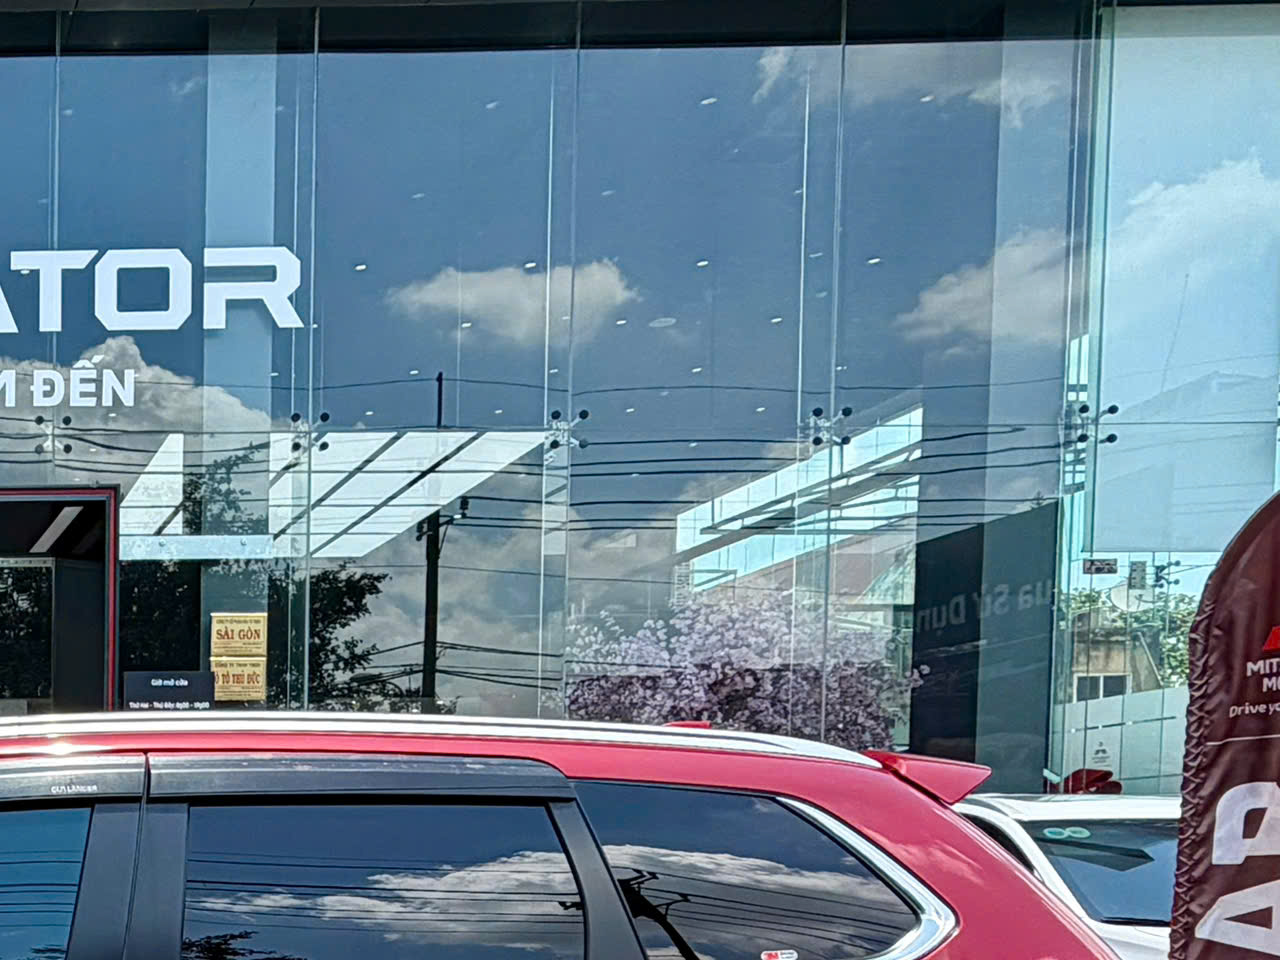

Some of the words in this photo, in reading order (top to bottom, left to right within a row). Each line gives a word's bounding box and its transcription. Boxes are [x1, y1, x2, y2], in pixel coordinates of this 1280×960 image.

[33, 354, 136, 409] ĐẾN
[216, 625, 234, 640] SÀI
[238, 625, 261, 640] GÒN
[1246, 658, 1280, 677] MIT
[1229, 702, 1267, 718] Drive
